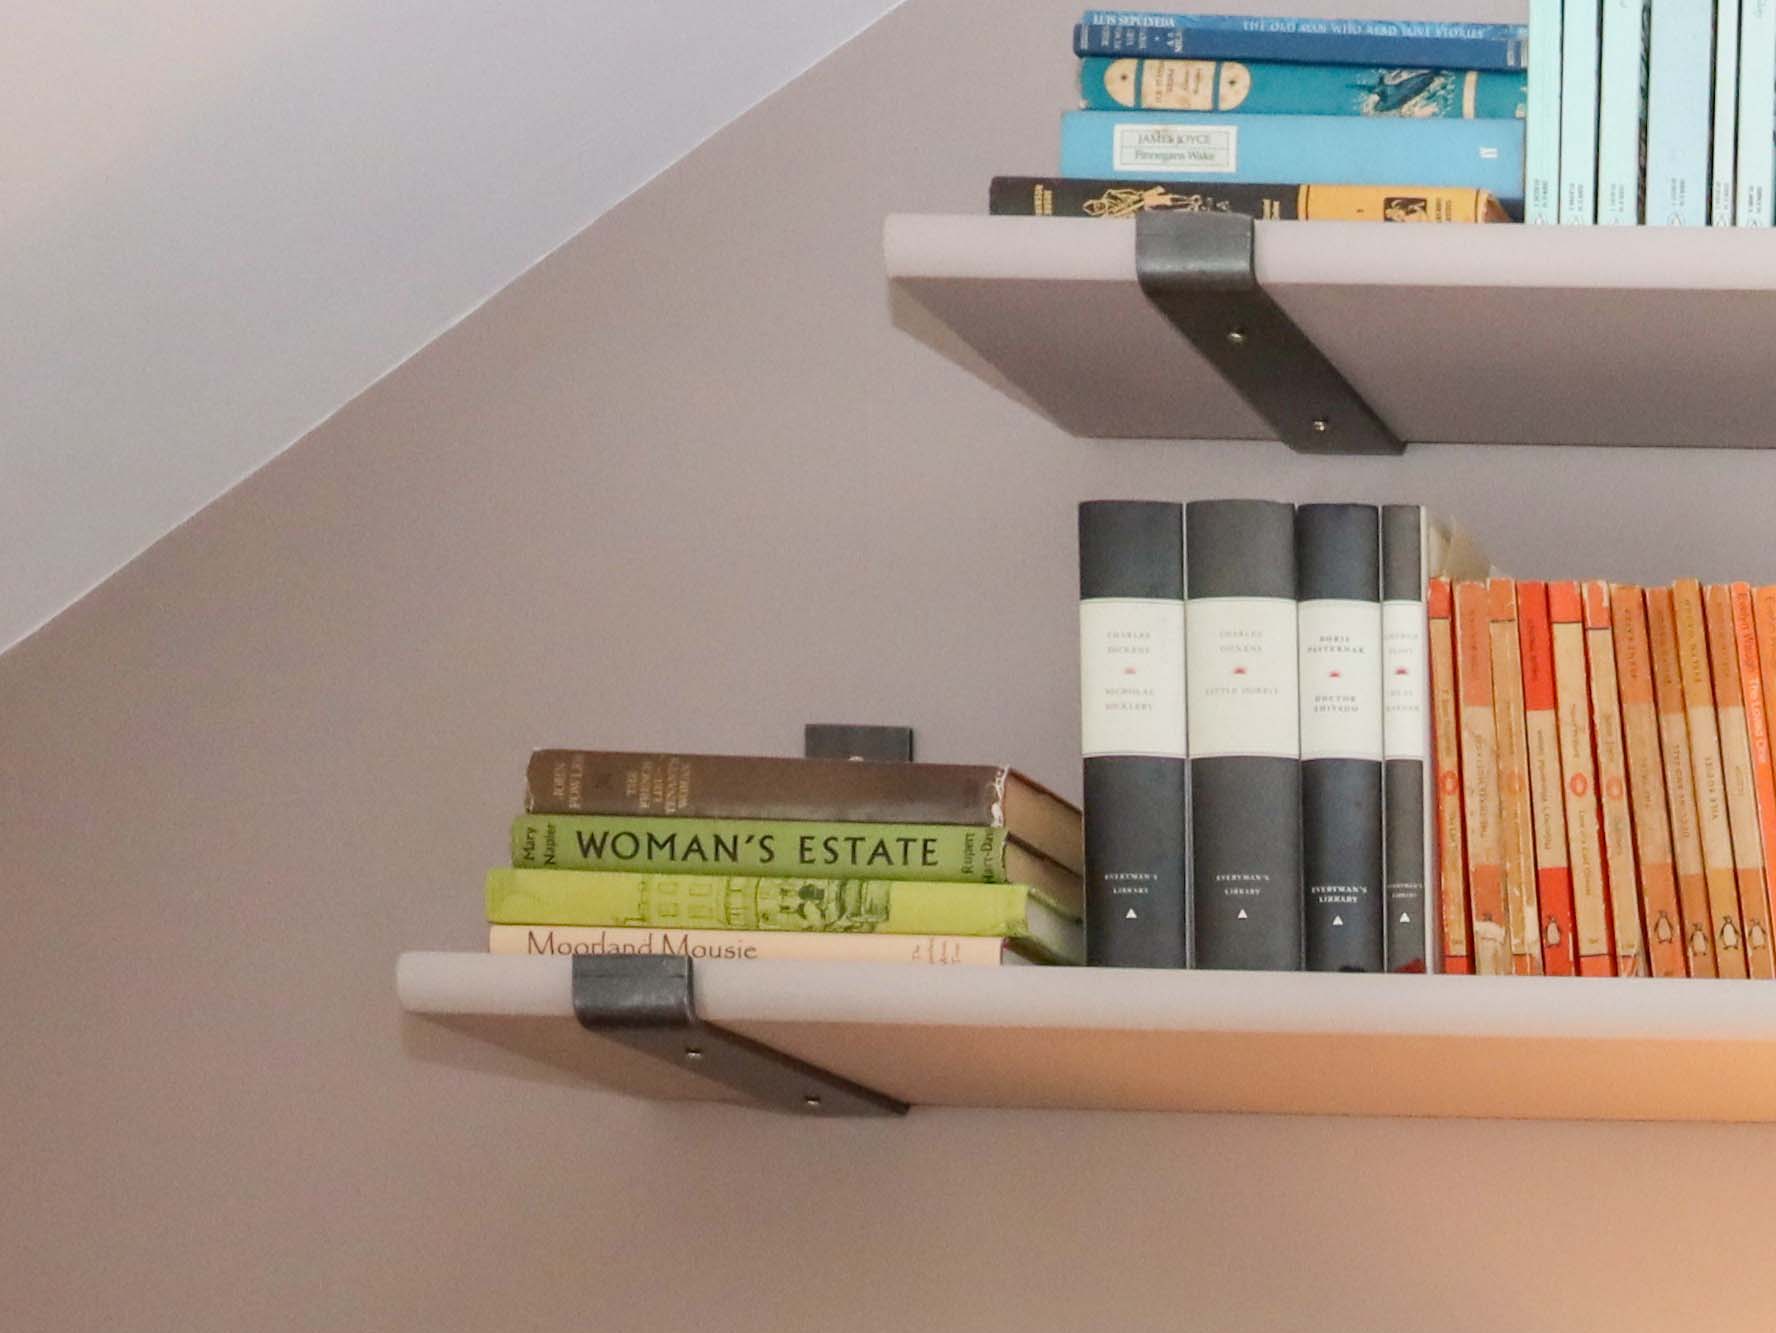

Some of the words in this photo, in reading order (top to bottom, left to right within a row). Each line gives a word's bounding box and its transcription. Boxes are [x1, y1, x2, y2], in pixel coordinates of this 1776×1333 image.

[523, 826, 538, 862] Mary
[543, 822, 558, 867] Napier
[576, 829, 778, 865] WOMAN'S
[799, 834, 940, 867] ESTATE
[526, 929, 653, 957] Moorland
[661, 932, 759, 961] Mousie
